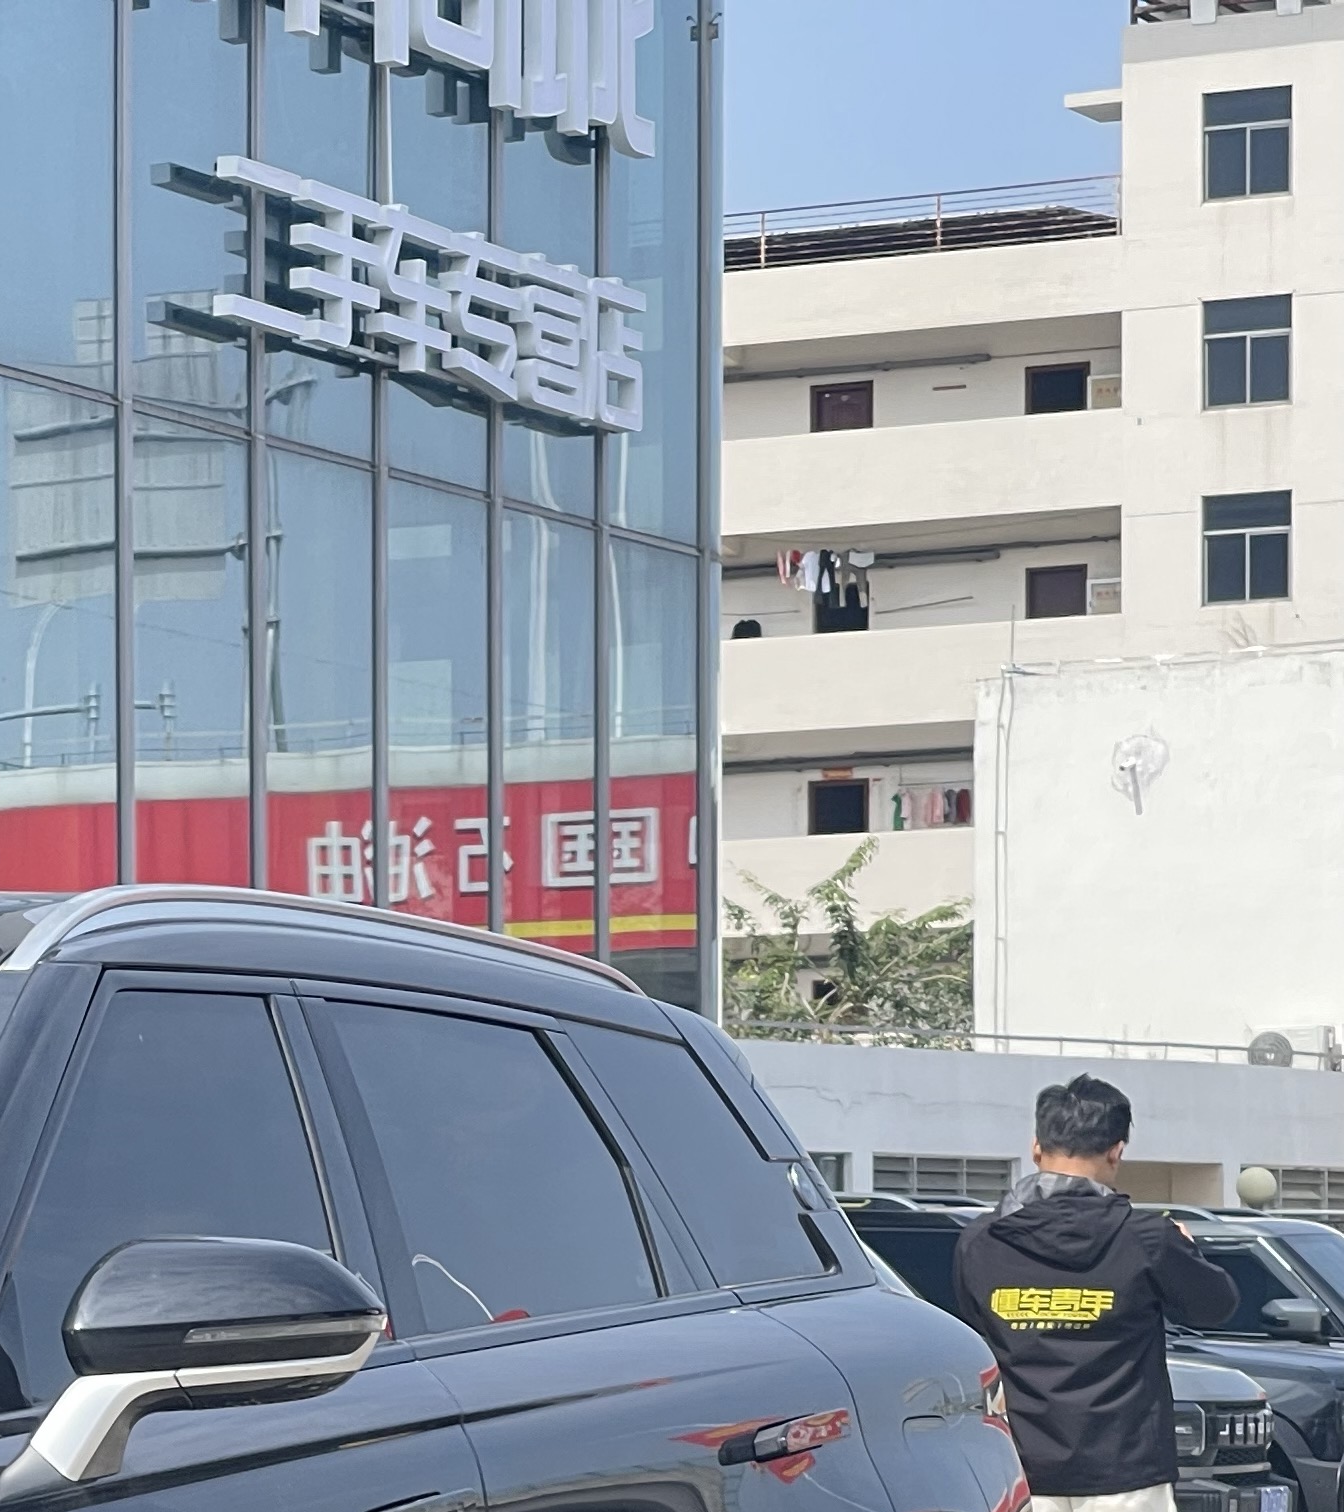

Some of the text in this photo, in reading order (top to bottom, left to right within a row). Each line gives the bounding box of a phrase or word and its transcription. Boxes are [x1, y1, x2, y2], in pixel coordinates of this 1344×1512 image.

[212, 155, 647, 433] 二手车专营店
